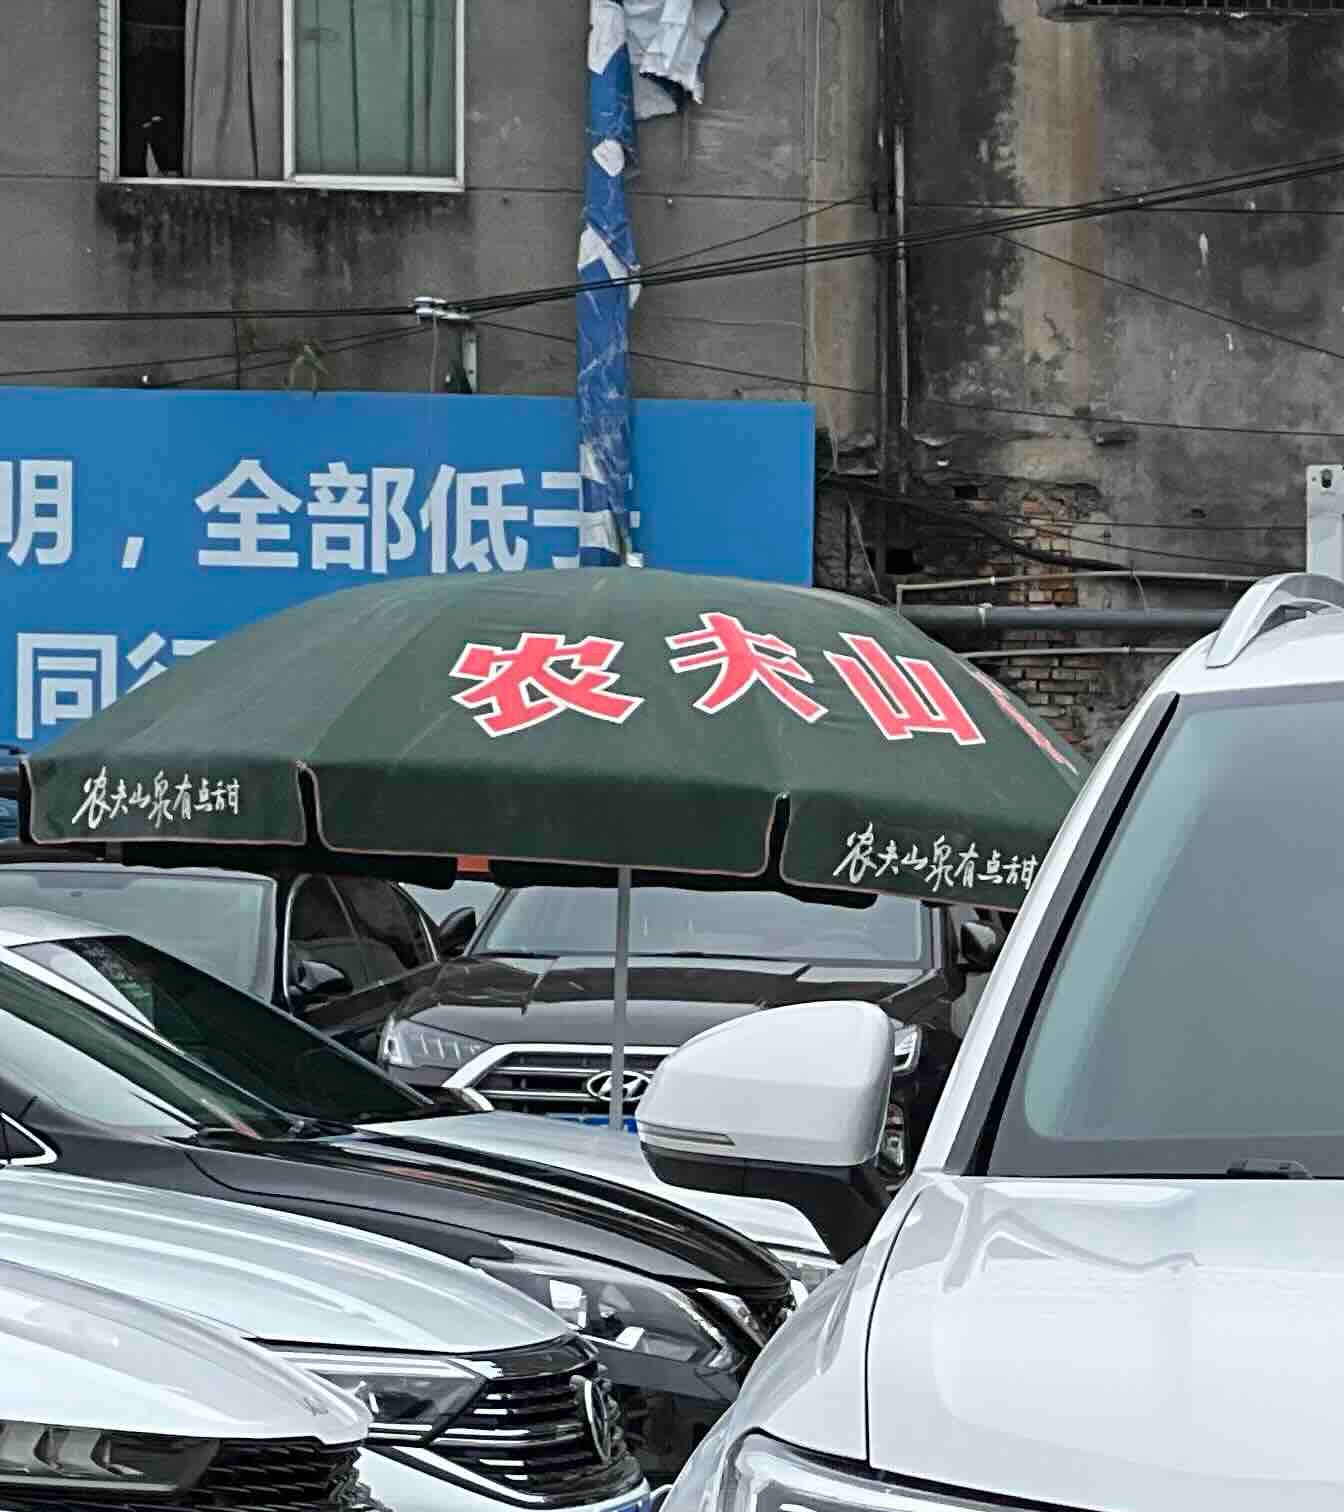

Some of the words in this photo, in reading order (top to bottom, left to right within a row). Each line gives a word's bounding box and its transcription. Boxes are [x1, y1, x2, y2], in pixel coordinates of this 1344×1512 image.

[449, 612, 1079, 776] 农夫山
[71, 765, 240, 830] 农夫山泉有点甜
[832, 820, 1039, 892] 农夫山泉有点甜
